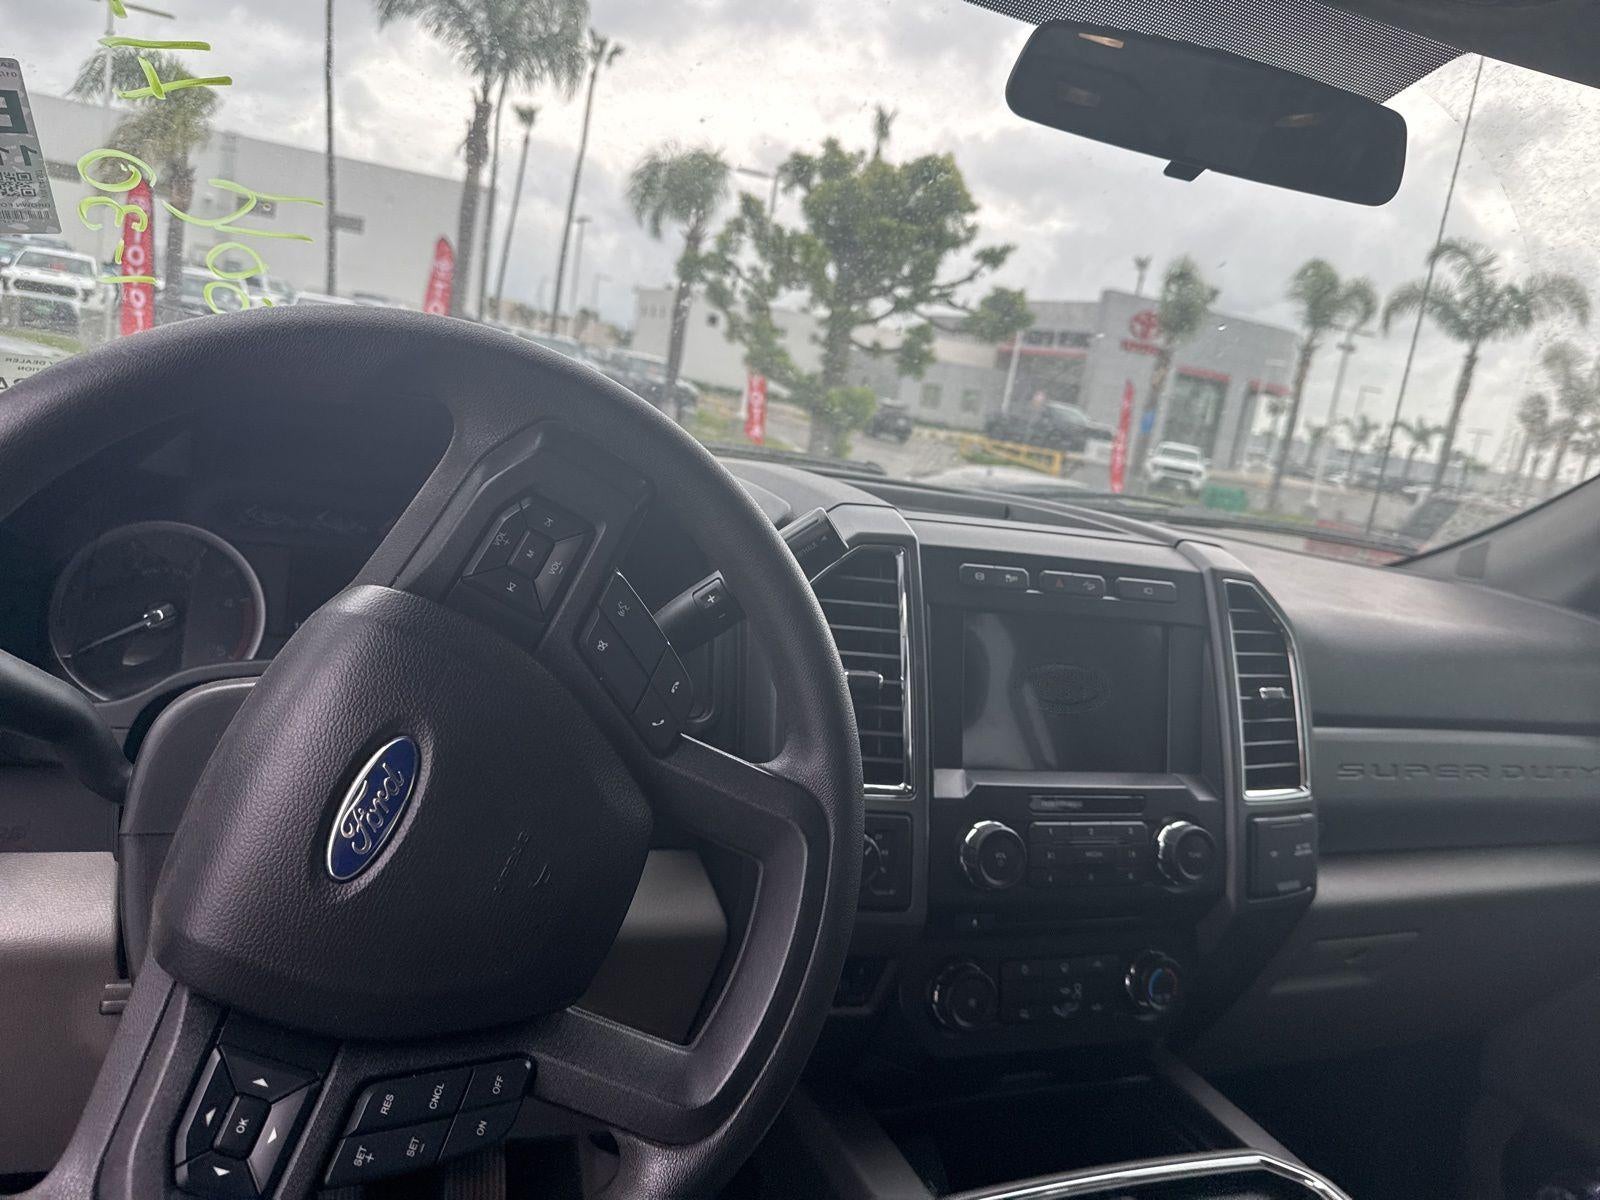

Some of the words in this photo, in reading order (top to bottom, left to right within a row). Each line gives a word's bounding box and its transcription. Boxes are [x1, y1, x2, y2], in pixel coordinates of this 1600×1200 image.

[548, 559, 562, 576] VOL
[1337, 763, 1490, 780] SUPER
[340, 762, 404, 855] Ford
[492, 1075, 504, 1095] OFF
[379, 1093, 395, 1116] RES
[428, 1083, 445, 1110] CNCL
[235, 1117, 249, 1135] OK
[476, 1120, 488, 1137] ON
[353, 1144, 368, 1167] SET
[406, 1136, 420, 1158] SET
